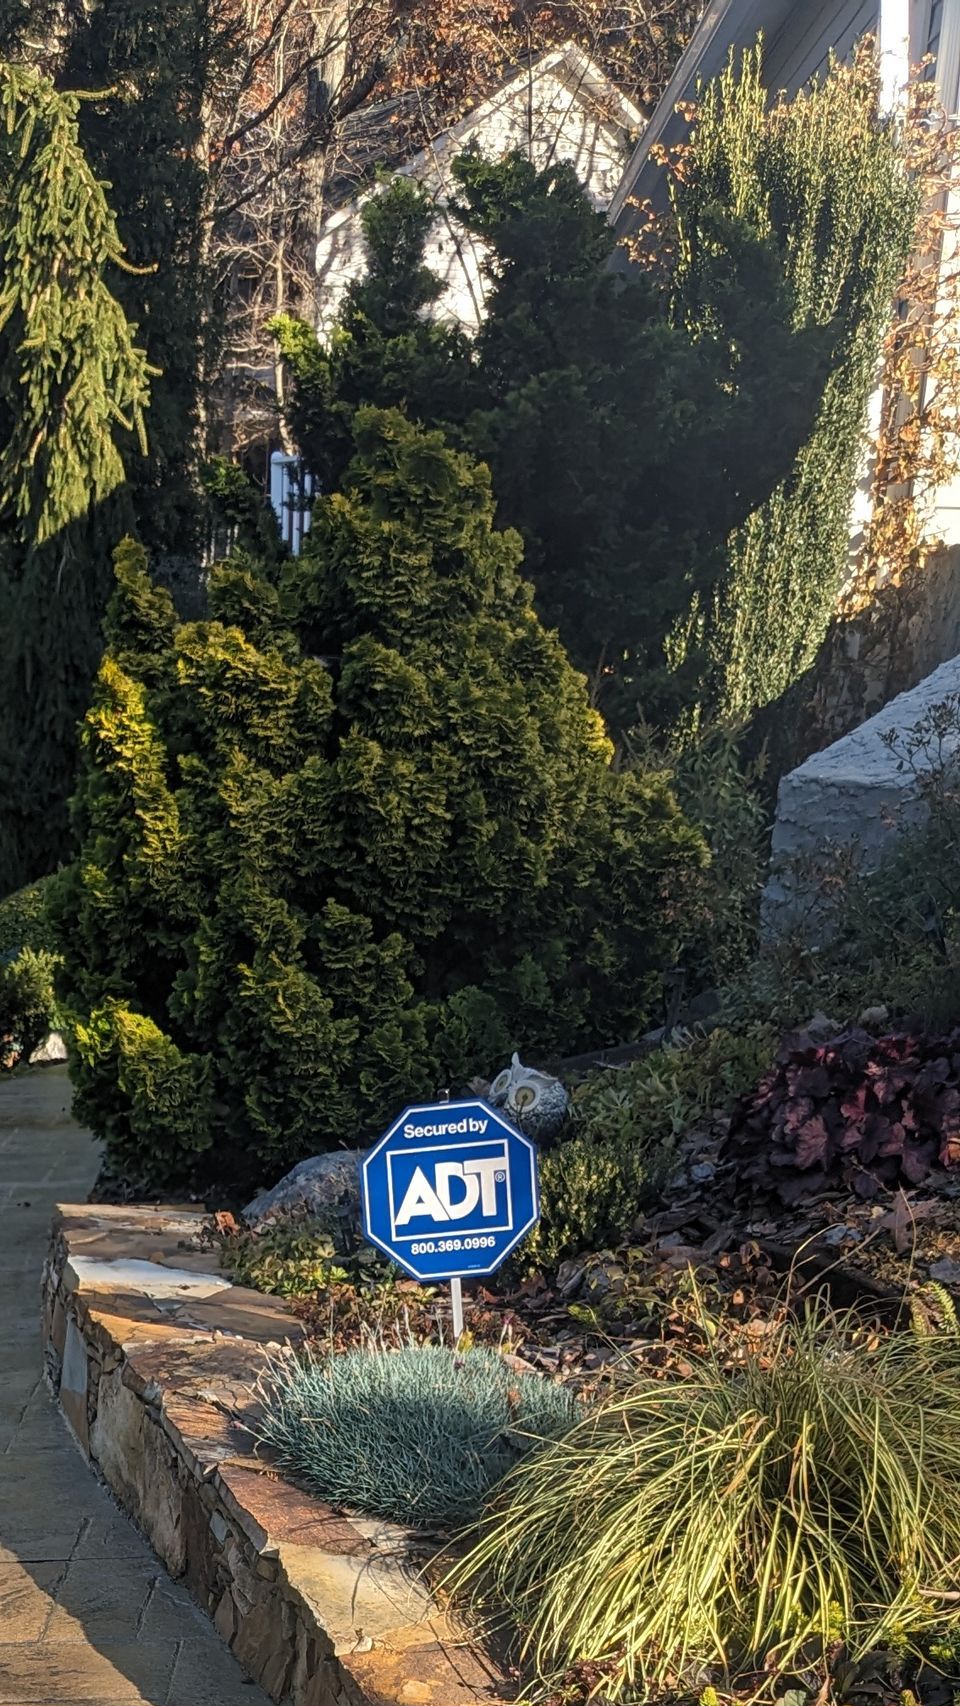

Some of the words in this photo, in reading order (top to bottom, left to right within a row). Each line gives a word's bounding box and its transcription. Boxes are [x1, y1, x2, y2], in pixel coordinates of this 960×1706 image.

[403, 1119, 467, 1139] Secured
[469, 1117, 488, 1134] by
[394, 1157, 507, 1226] ADT
[411, 1236, 496, 1255] 800.369.0996
